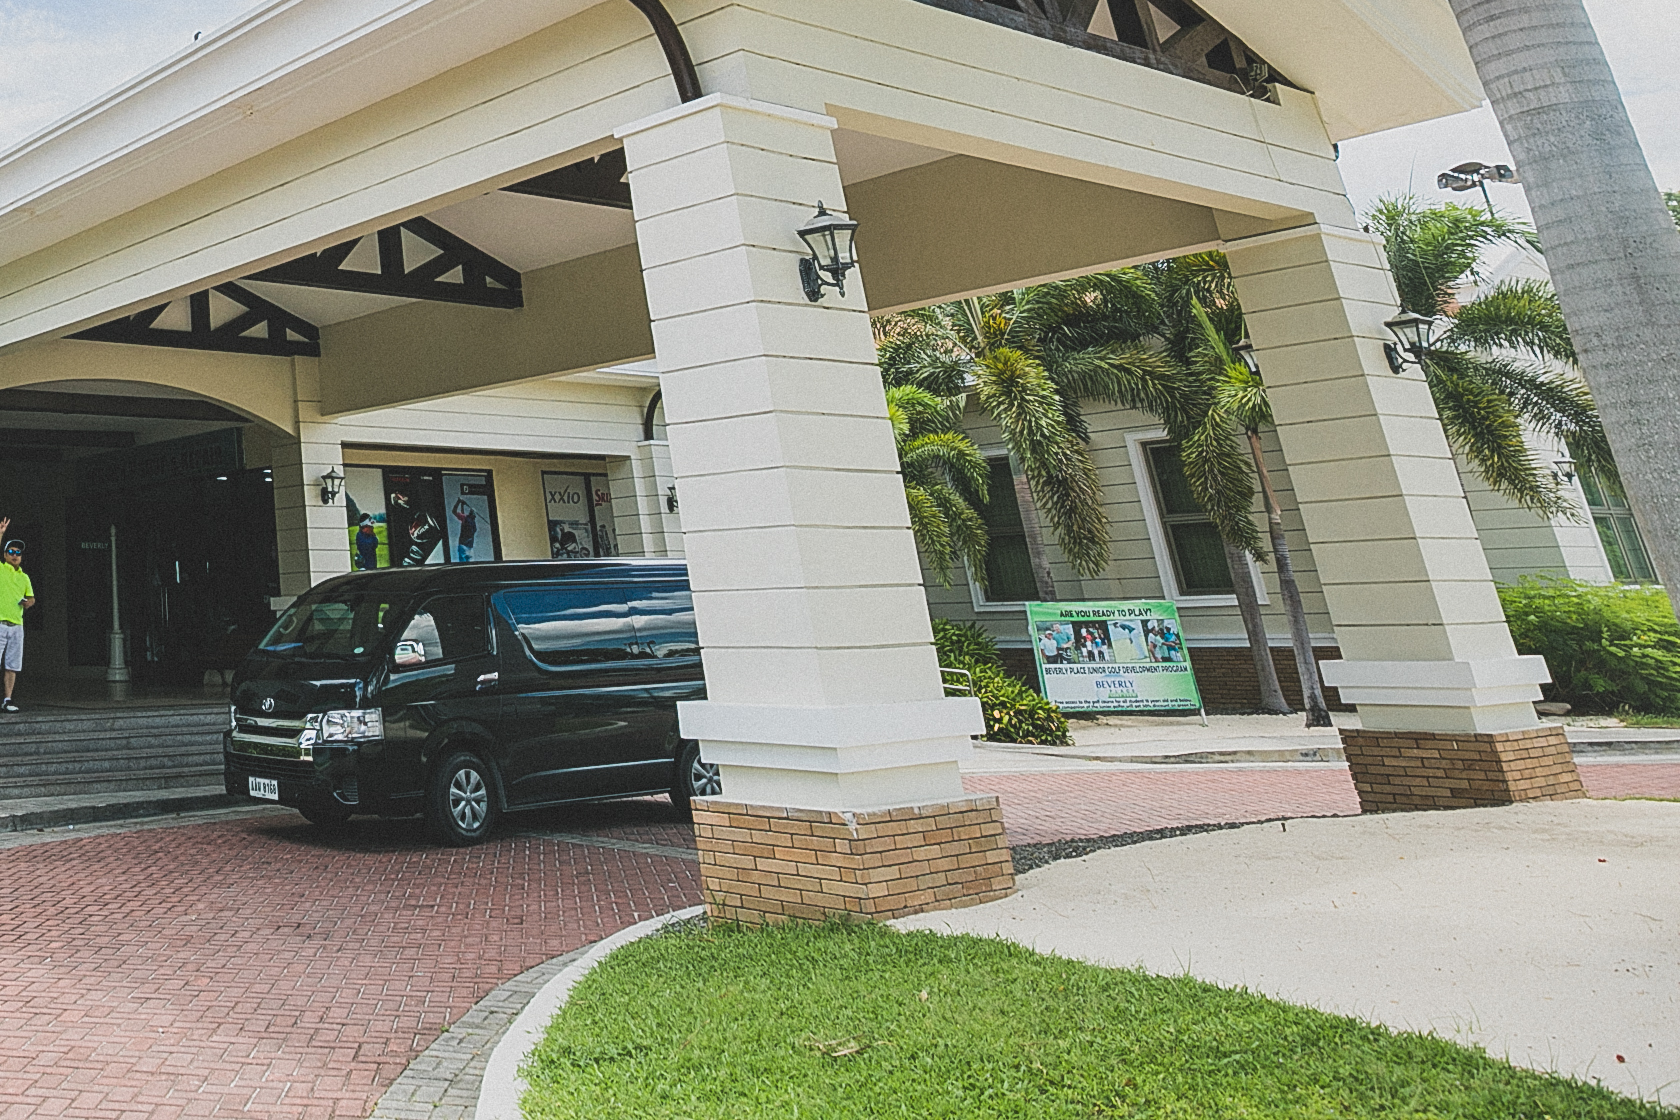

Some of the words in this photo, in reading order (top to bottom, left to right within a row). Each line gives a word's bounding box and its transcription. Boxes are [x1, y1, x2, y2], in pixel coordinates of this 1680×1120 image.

[548, 484, 580, 504] XXIO
[1060, 609, 1074, 618] ARE
[1074, 609, 1091, 618] YOU
[1091, 609, 1115, 618] READY
[1116, 609, 1127, 617] TO
[1127, 608, 1152, 617] PLAY?
[1045, 666, 1068, 675] BEVERLY
[1069, 666, 1087, 675] PLACE
[1087, 666, 1106, 674] JUNIOR
[1107, 666, 1121, 674] GOLF
[1121, 665, 1160, 674] DEVELOPMENT
[1161, 665, 1189, 673] PROGRAM
[1095, 680, 1133, 688] BEVERLY
